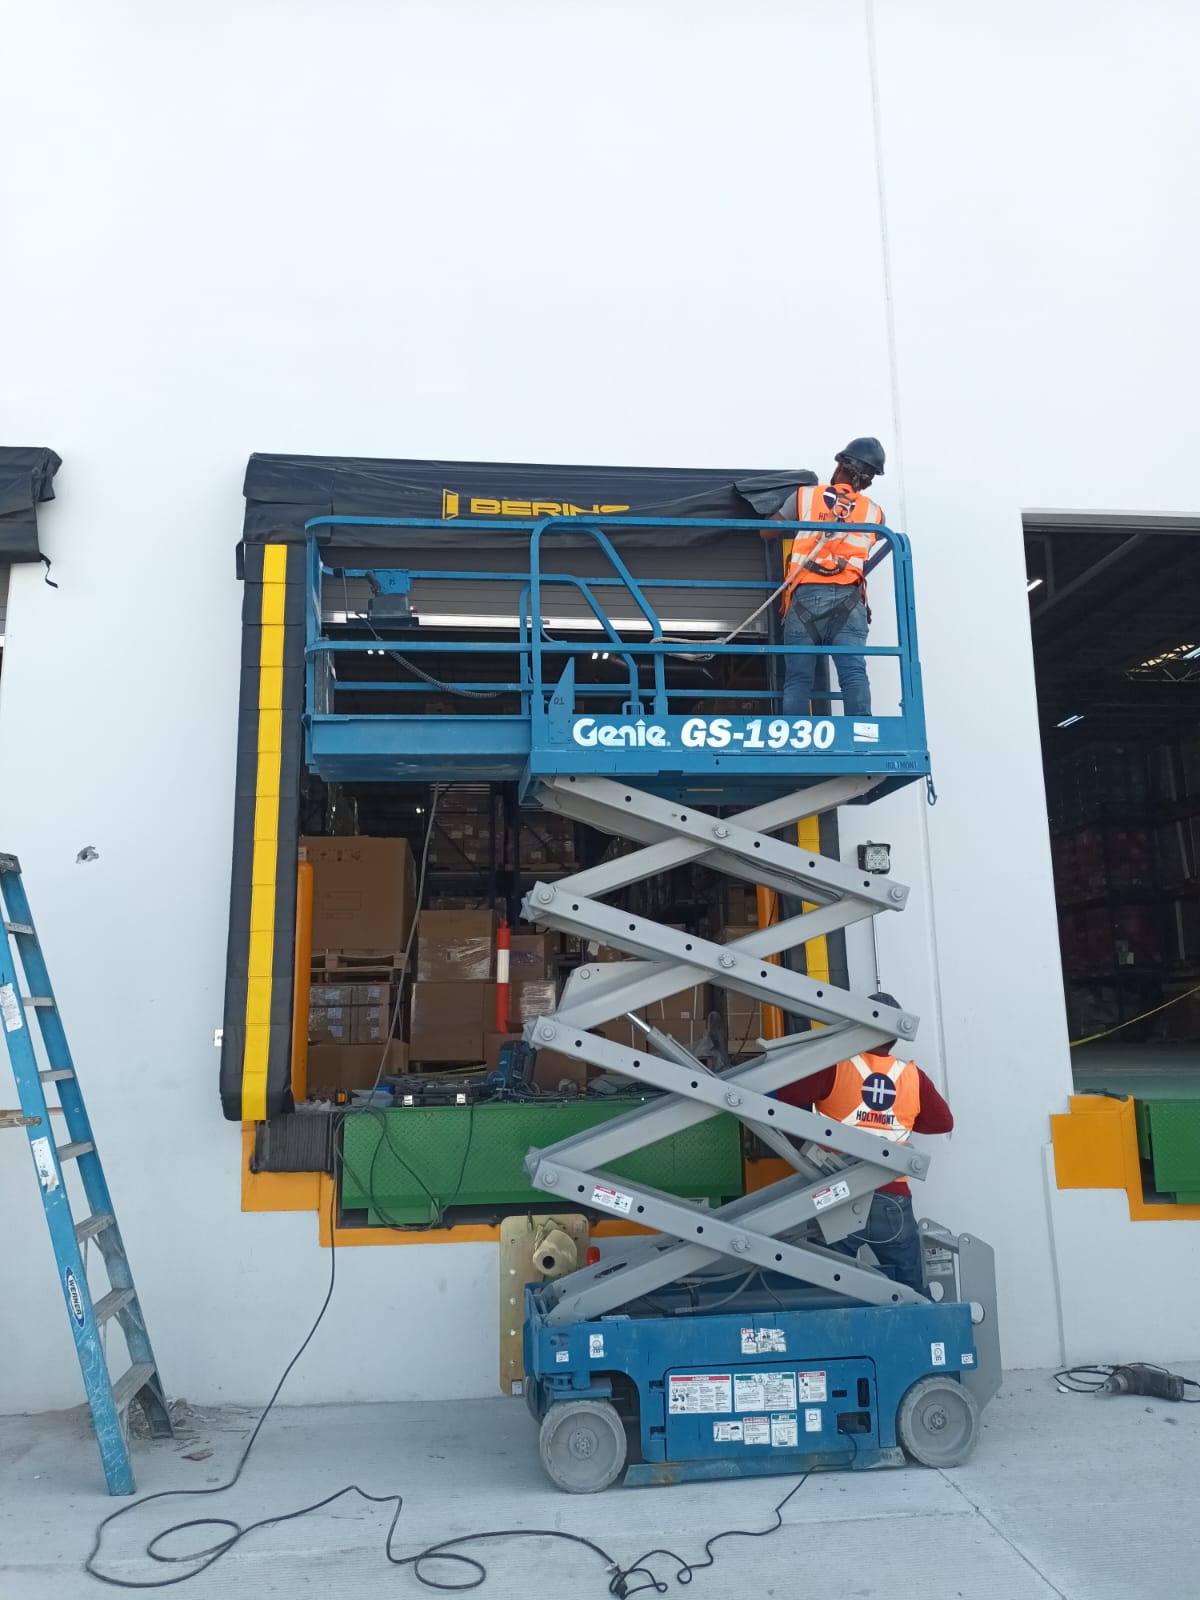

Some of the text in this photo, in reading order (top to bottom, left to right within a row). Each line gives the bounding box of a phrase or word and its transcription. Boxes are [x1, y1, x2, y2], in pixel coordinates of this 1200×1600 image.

[573, 718, 836, 749] Genie GS-1930
[856, 1110, 895, 1125] HOLTMONT
[69, 1279, 82, 1316] WERNER
